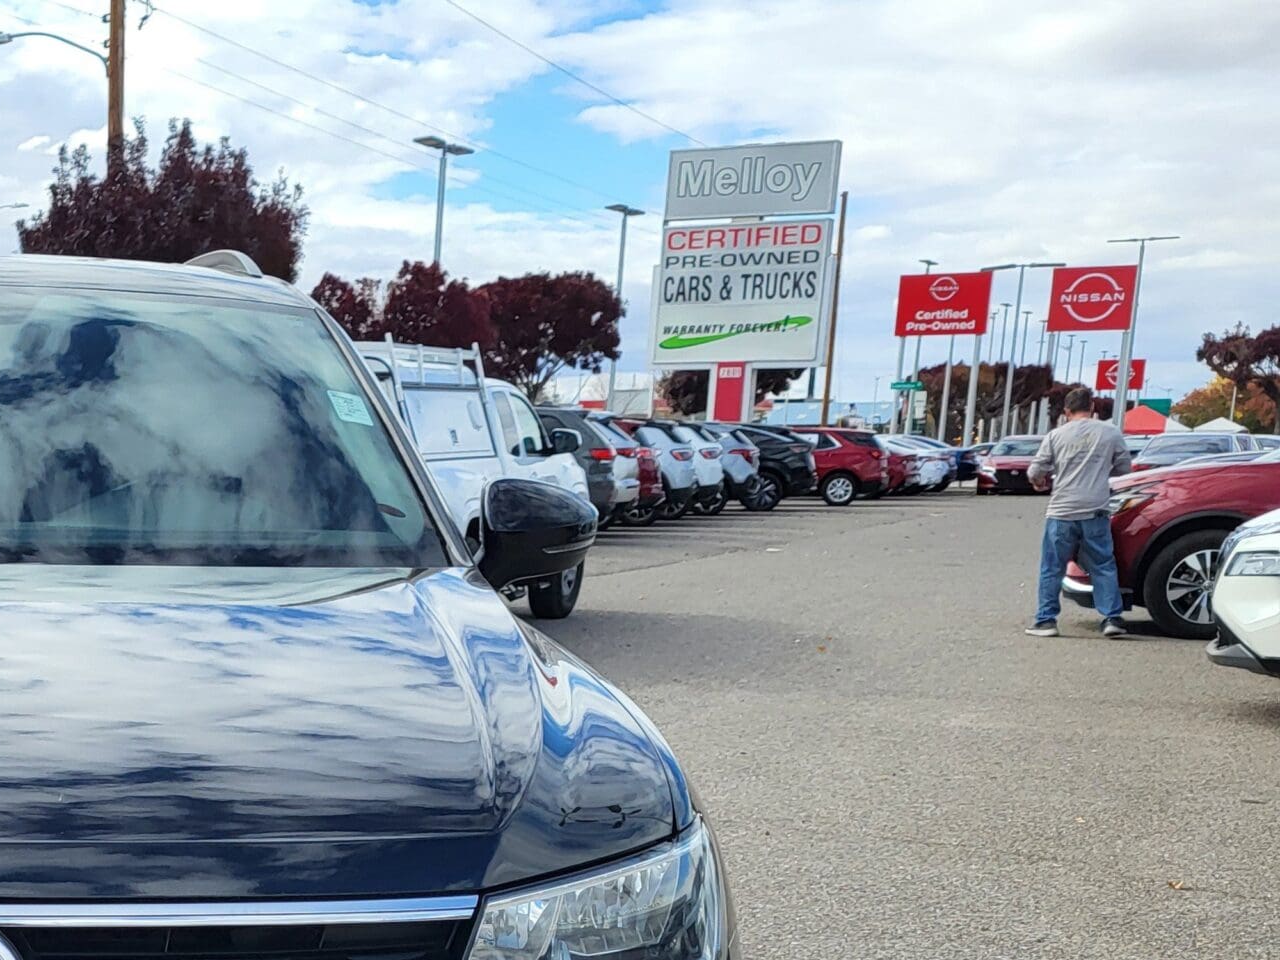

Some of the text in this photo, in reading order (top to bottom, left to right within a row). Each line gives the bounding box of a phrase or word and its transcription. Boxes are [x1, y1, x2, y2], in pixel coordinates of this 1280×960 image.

[677, 157, 822, 201] Melloy
[667, 224, 822, 251] CERTIFIED
[665, 250, 820, 269] PRE-OWNED
[664, 271, 817, 303] CARS & TRUCKS
[1060, 292, 1125, 303] NISSAN
[915, 309, 969, 321] Certified
[663, 323, 726, 335] WARRANTY
[905, 320, 975, 332] Pre-Owned
